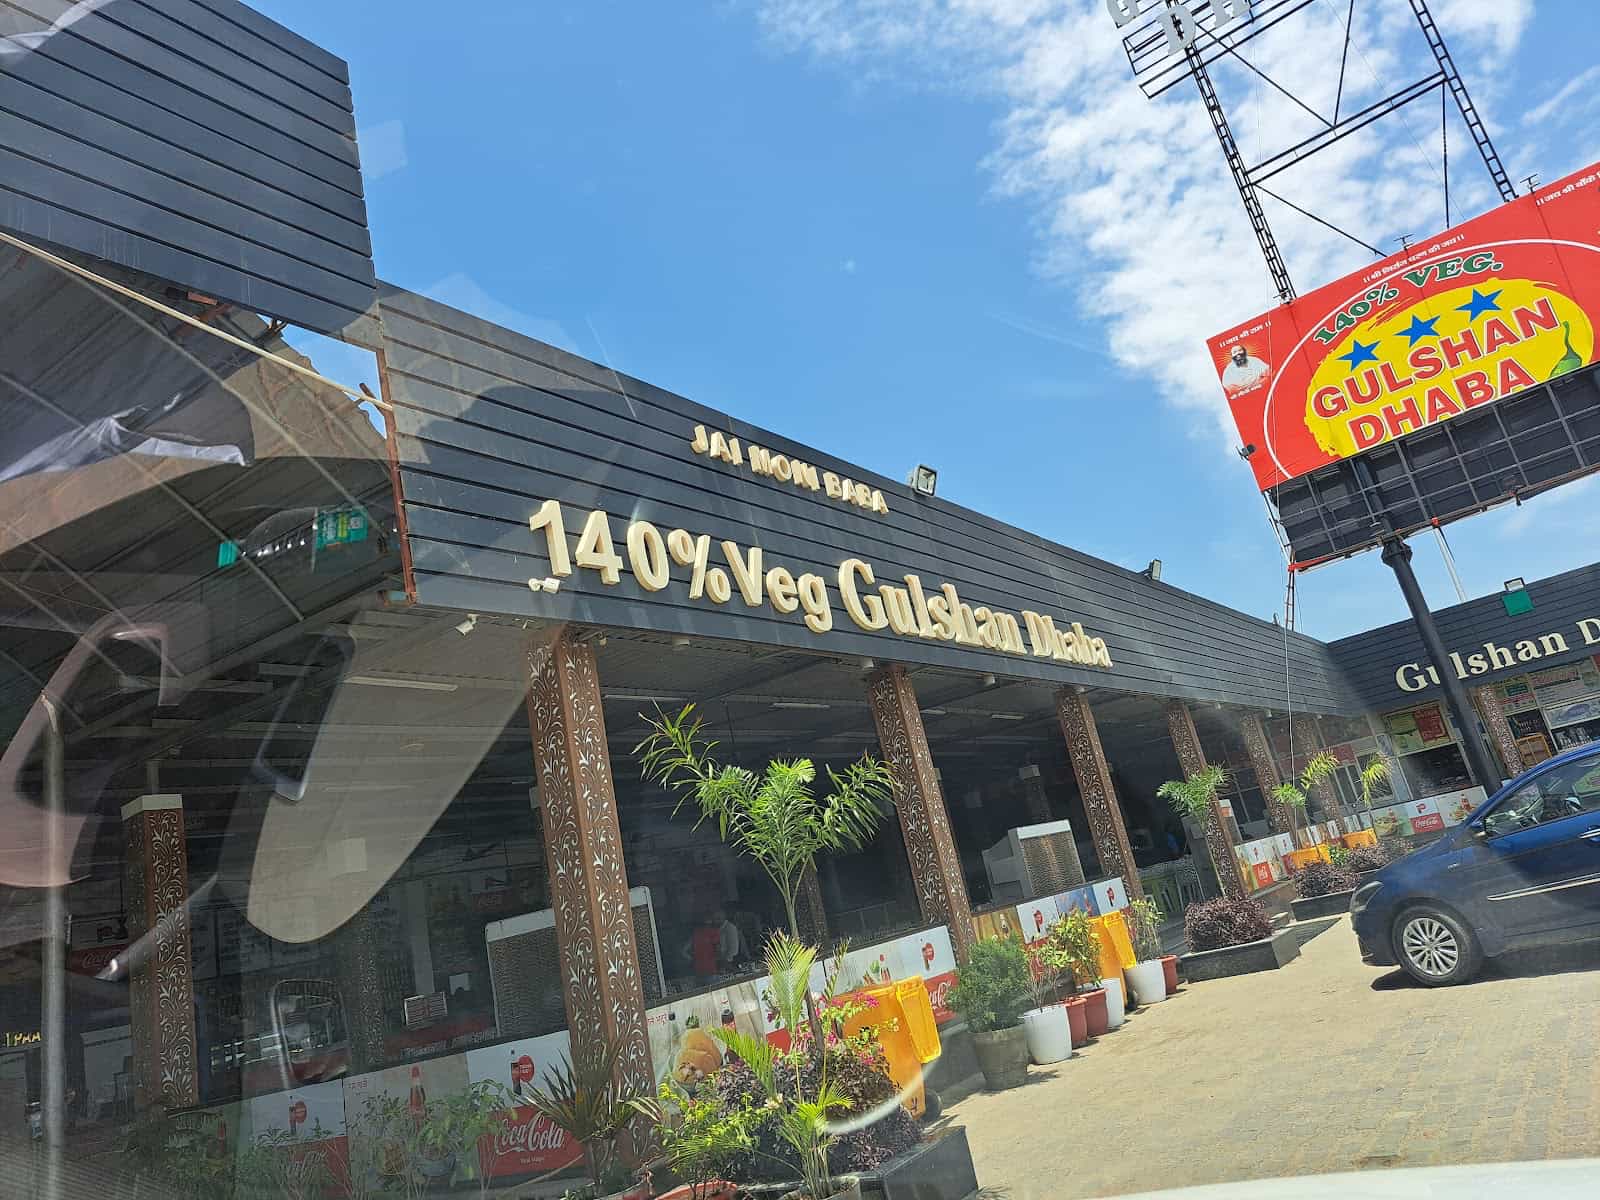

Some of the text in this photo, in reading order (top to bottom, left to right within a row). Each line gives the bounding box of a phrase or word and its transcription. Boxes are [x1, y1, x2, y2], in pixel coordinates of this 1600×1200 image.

[1314, 251, 1503, 344] 140% VEG.
[1312, 297, 1561, 418] GULSHAN
[1348, 357, 1539, 452] DHABA
[690, 424, 744, 466] JAI
[822, 471, 890, 515] BABA
[838, 558, 1028, 655] Gulshan
[1021, 610, 1114, 669] Dhaba
